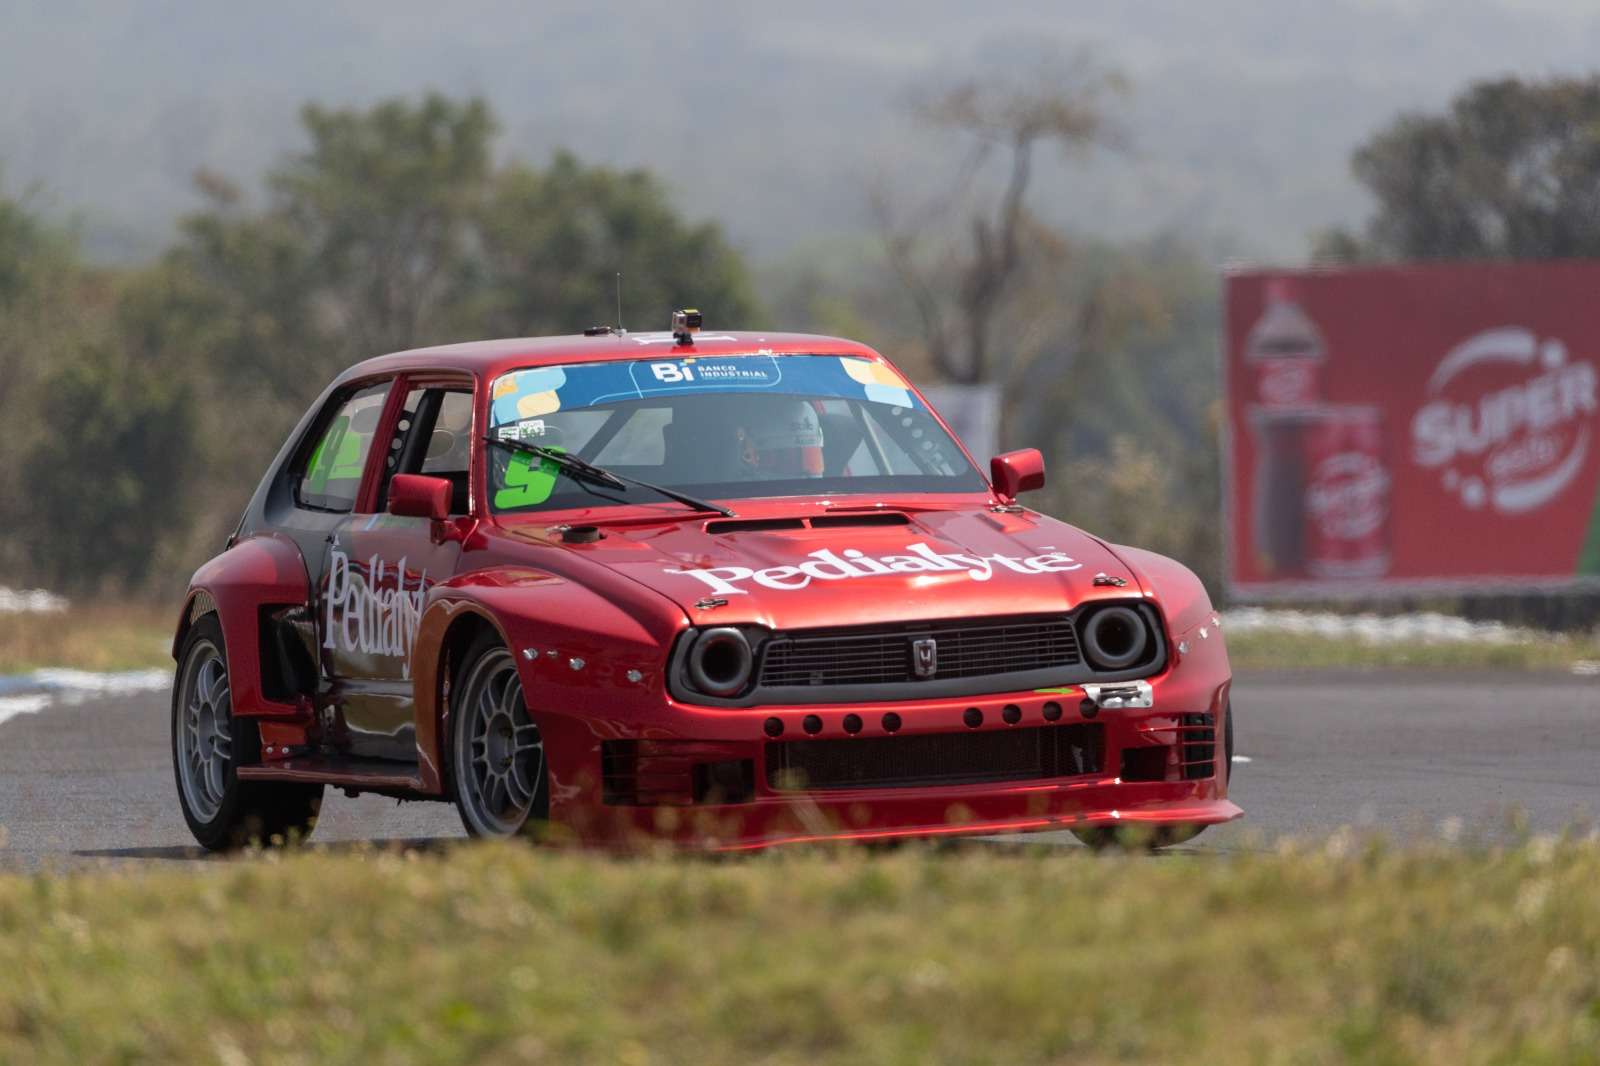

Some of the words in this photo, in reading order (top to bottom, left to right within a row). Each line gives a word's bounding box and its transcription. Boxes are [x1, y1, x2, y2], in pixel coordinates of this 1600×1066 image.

[651, 358, 696, 382] Bi
[700, 370, 768, 378] INDUSTRIAL
[1411, 361, 1596, 466] SUPER
